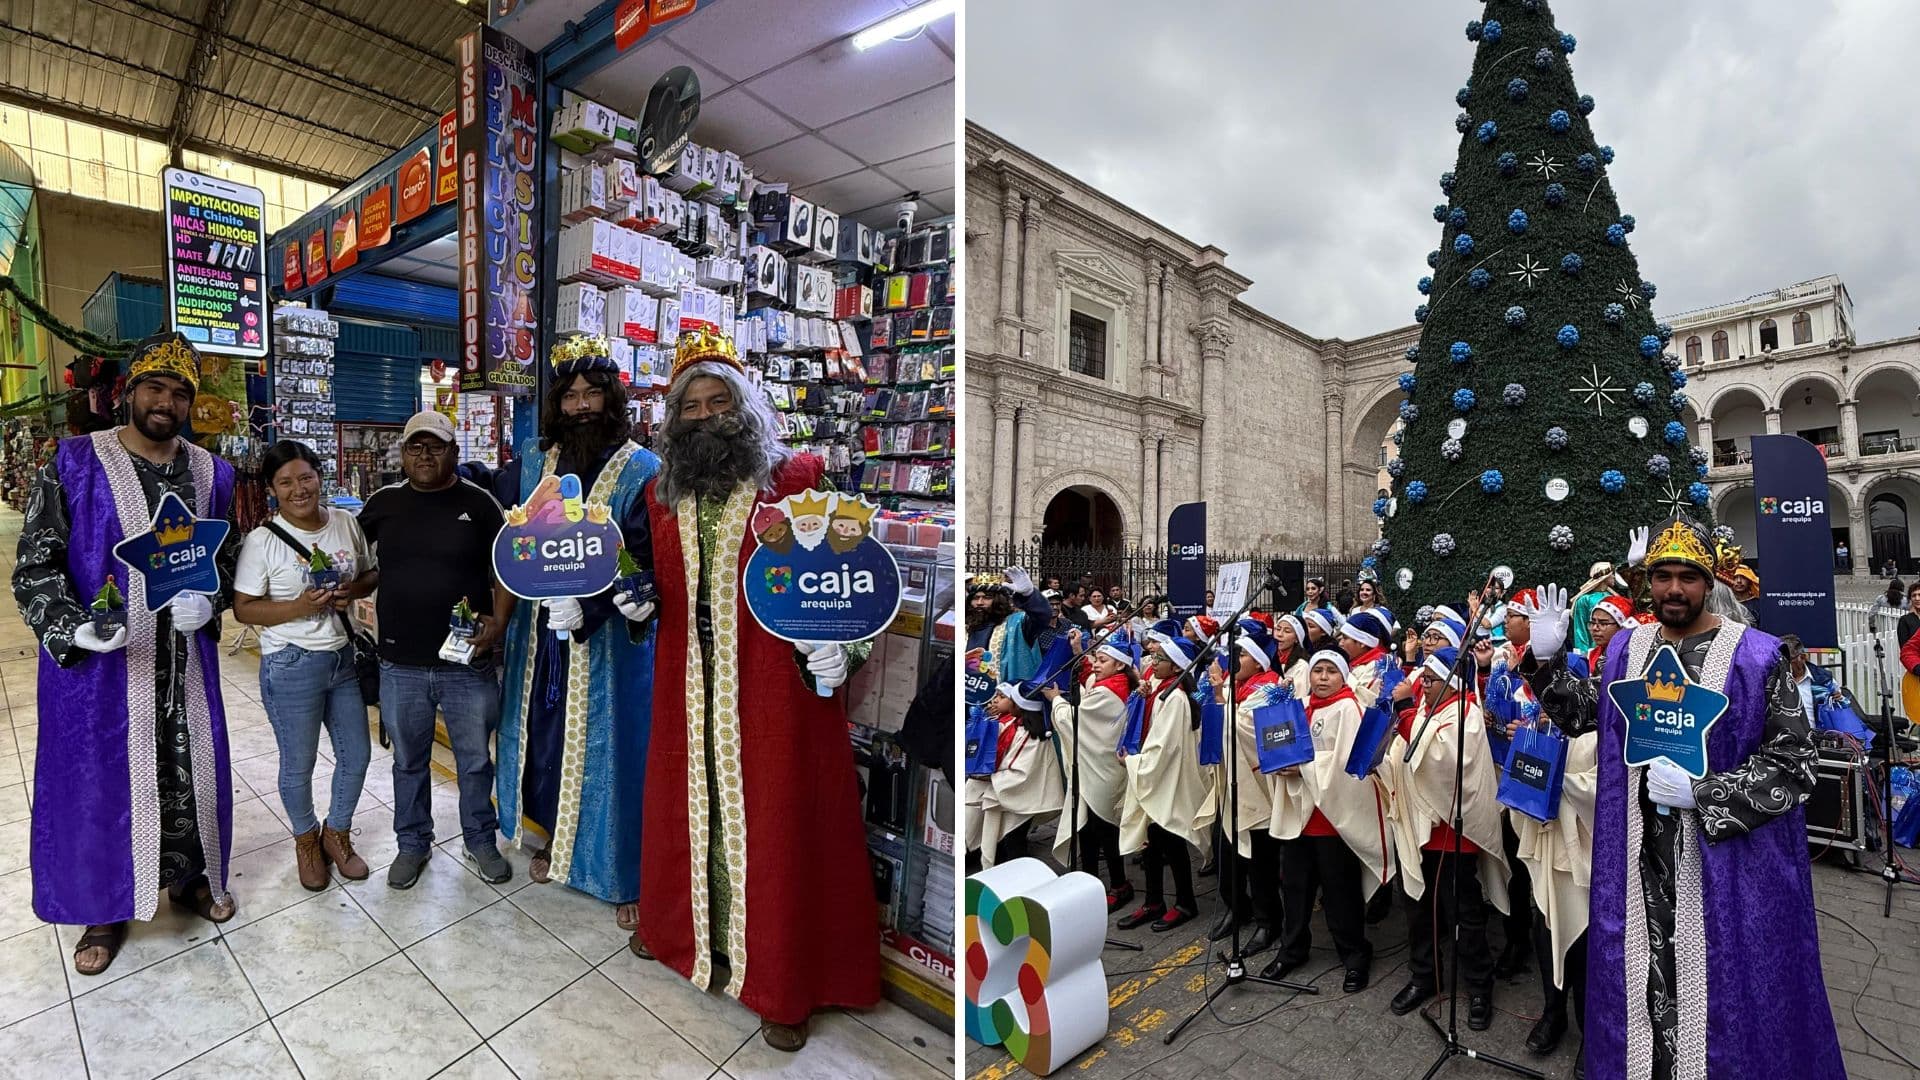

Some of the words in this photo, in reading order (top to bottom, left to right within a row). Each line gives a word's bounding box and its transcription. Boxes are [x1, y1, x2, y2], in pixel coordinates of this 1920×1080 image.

[504, 36, 516, 53] SE
[484, 43, 536, 84] DESCARGA
[462, 32, 475, 127] USB
[651, 132, 689, 171] MOVISUN
[403, 181, 423, 200] Claro
[170, 187, 260, 220] IMPORTACIONES
[189, 206, 200, 217] El
[203, 210, 244, 227] Chinito
[511, 84, 538, 365] MUSICAS
[173, 214, 205, 233] MICAS
[207, 222, 258, 244] HIDROGEL
[364, 222, 383, 235] ACTIVA
[176, 233, 192, 244] HD
[176, 248, 203, 261] MATE
[463, 152, 478, 371] GRABADOS
[177, 263, 233, 281] ANTIESPIAS
[177, 273, 208, 285] VIDRIOS
[209, 278, 240, 290] CURVOS
[176, 283, 238, 301] CARGADORES
[177, 296, 233, 312] AUDIFONOS
[177, 306, 191, 315] USB
[191, 308, 223, 319] GRABADO
[203, 318, 208, 326] Y
[208, 319, 240, 331] PELICULAS
[504, 361, 521, 372] USB
[488, 371, 536, 387] GRABADOS
[1780, 496, 1824, 517] caja
[1781, 516, 1812, 524] arequipa
[168, 543, 207, 565] caja
[541, 531, 603, 562] caja
[1181, 543, 1204, 557] caja
[171, 562, 198, 573] arequipa
[543, 562, 586, 572] arequipa
[798, 563, 875, 599] caja
[800, 599, 852, 610] arequipa
[1654, 708, 1695, 729] caja
[1273, 728, 1290, 739] caja
[1654, 726, 1683, 735] arequipa
[1524, 764, 1543, 777] caja
[909, 946, 955, 977] Clar
